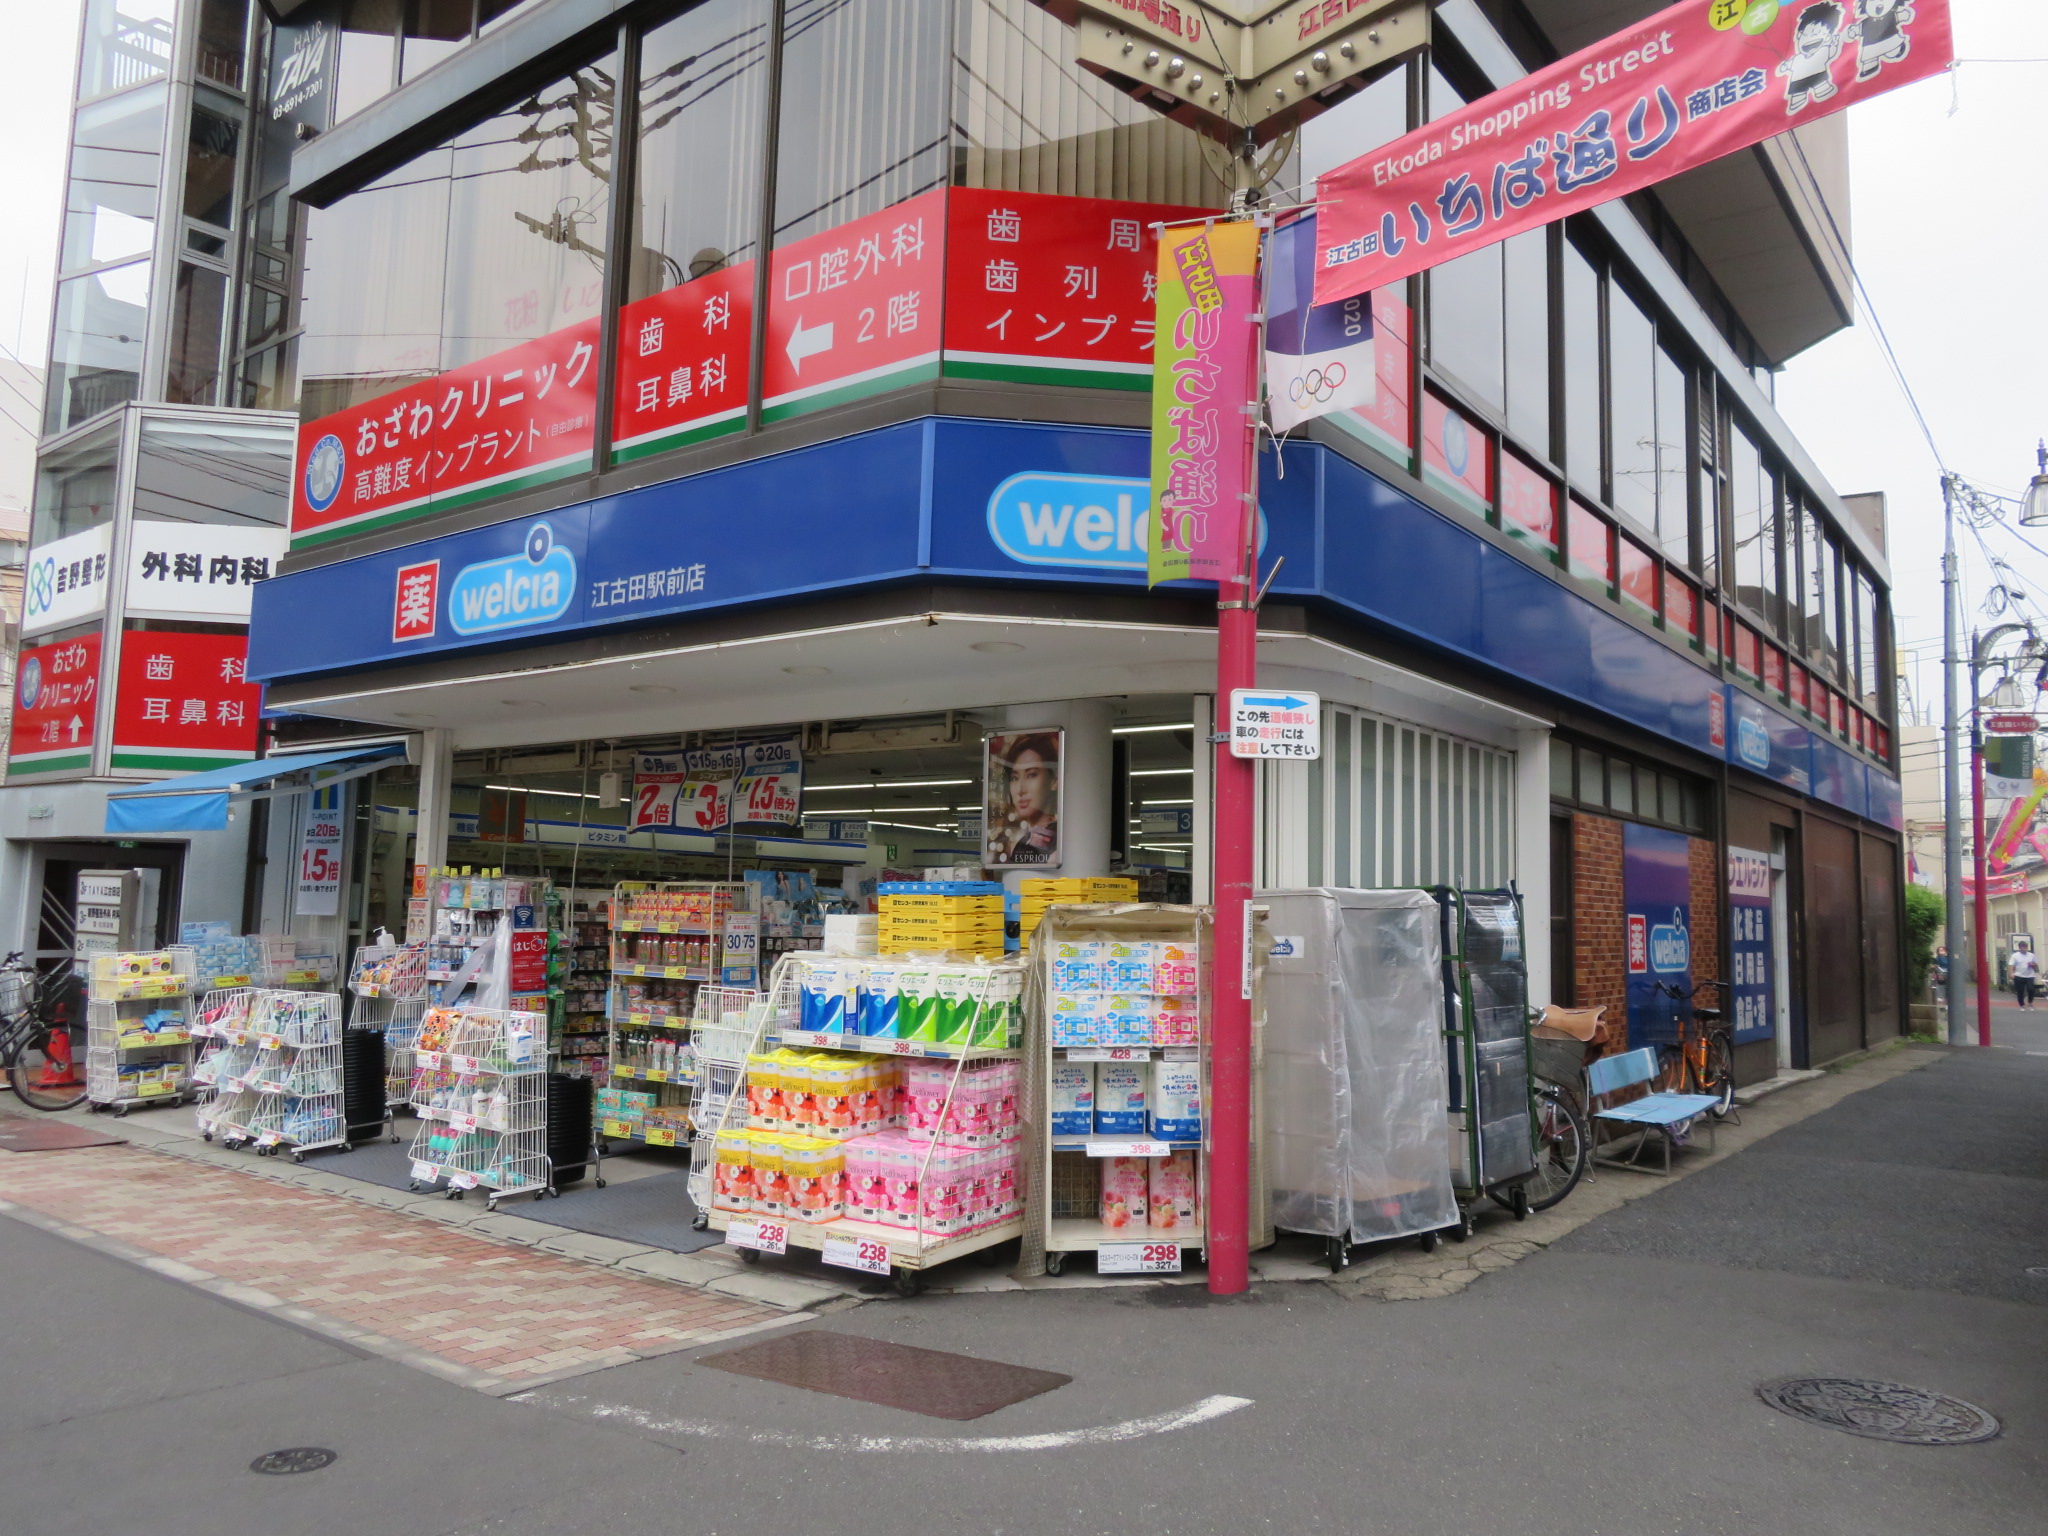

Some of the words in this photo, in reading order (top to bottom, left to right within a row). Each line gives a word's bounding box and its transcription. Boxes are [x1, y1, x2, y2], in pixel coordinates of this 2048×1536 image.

[293, 21, 322, 53] HAIR
[274, 32, 328, 101] TAYA
[273, 78, 323, 120] 03-6914-7201
[1372, 142, 1443, 187] Ekoda
[1451, 80, 1572, 152] Shopping
[1579, 29, 1674, 93] Street
[1326, 232, 1379, 267] 江古田
[1381, 84, 1681, 257] いちば通り
[1686, 67, 1768, 124] 商店会
[785, 217, 925, 301] 口腔外科
[857, 290, 921, 344] 2階
[635, 353, 727, 413] 耳鼻科
[356, 341, 594, 456] おざわクリニック
[354, 418, 542, 504] 高難度インプラント
[57, 552, 107, 594] 吉野整形
[142, 552, 270, 586] 外科内科
[462, 566, 560, 622] welcia
[592, 563, 706, 609] 江古田駅前店
[401, 574, 431, 628] 薬
[53, 644, 87, 672] おざわ
[40, 678, 96, 710] クリニック
[142, 697, 245, 727] 耳鼻科
[1236, 710, 1316, 725] この先道幅狭し
[41, 720, 60, 743] 2階
[1235, 726, 1305, 740] 車の走行には
[1235, 742, 1316, 756] 注意して下さい
[1180, 812, 1191, 830] 3
[588, 831, 627, 844] ビタミン剤
[303, 849, 340, 881] 1.5倍
[1631, 922, 1644, 965] 薬
[1654, 932, 1687, 966] welcia
[162, 985, 176, 993] 598
[808, 975, 834, 984] エリエール
[867, 975, 893, 983] エリエール
[901, 976, 927, 984] エリエール
[938, 978, 965, 986] エリエール
[813, 1034, 828, 1046] 398
[894, 1042, 910, 1054] 398
[1110, 1050, 1131, 1060] 428
[618, 1123, 629, 1133] 598
[662, 1131, 673, 1140] 598
[1131, 1144, 1152, 1154] 398
[758, 1224, 785, 1243] 238
[766, 1241, 778, 1249] 261
[859, 1242, 887, 1262] 238
[1143, 1244, 1178, 1261] 298
[868, 1260, 881, 1269] 261
[1155, 1261, 1172, 1270] 327
